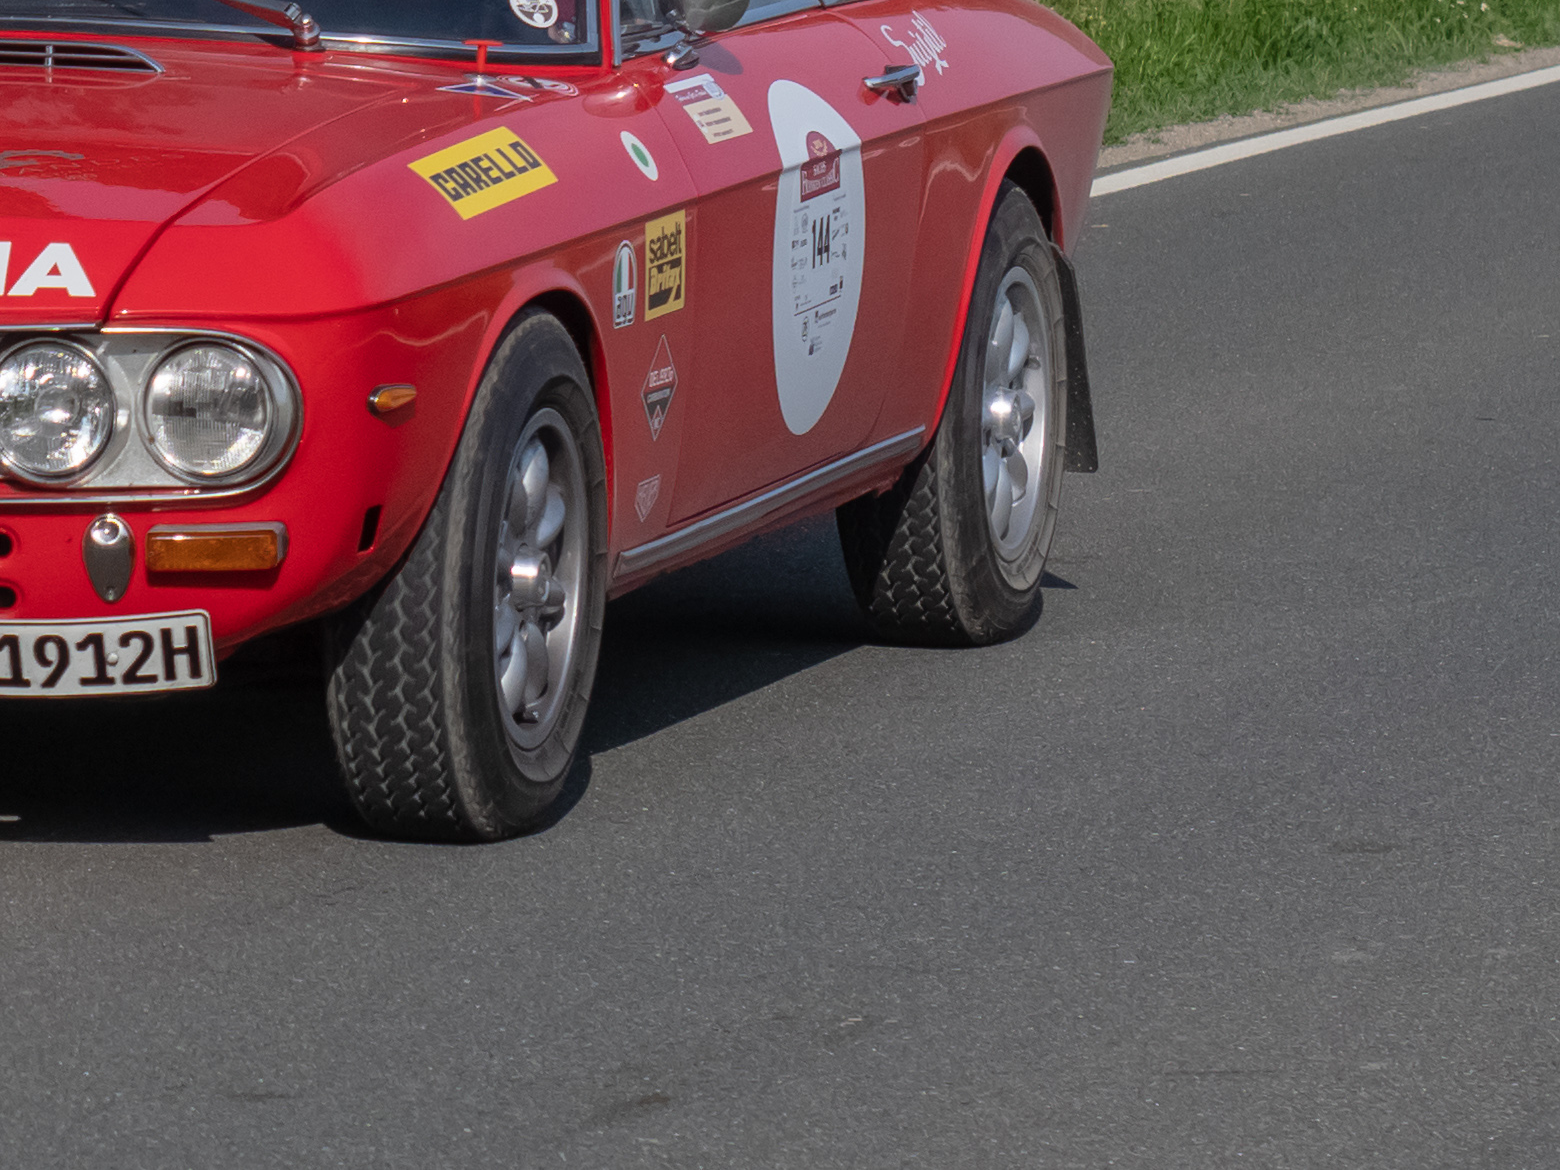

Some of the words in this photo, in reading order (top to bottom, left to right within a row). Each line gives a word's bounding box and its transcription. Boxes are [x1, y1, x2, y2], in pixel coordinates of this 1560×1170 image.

[428, 141, 542, 202] CARELLO
[648, 221, 682, 264] sabelt
[811, 214, 831, 269] 144
